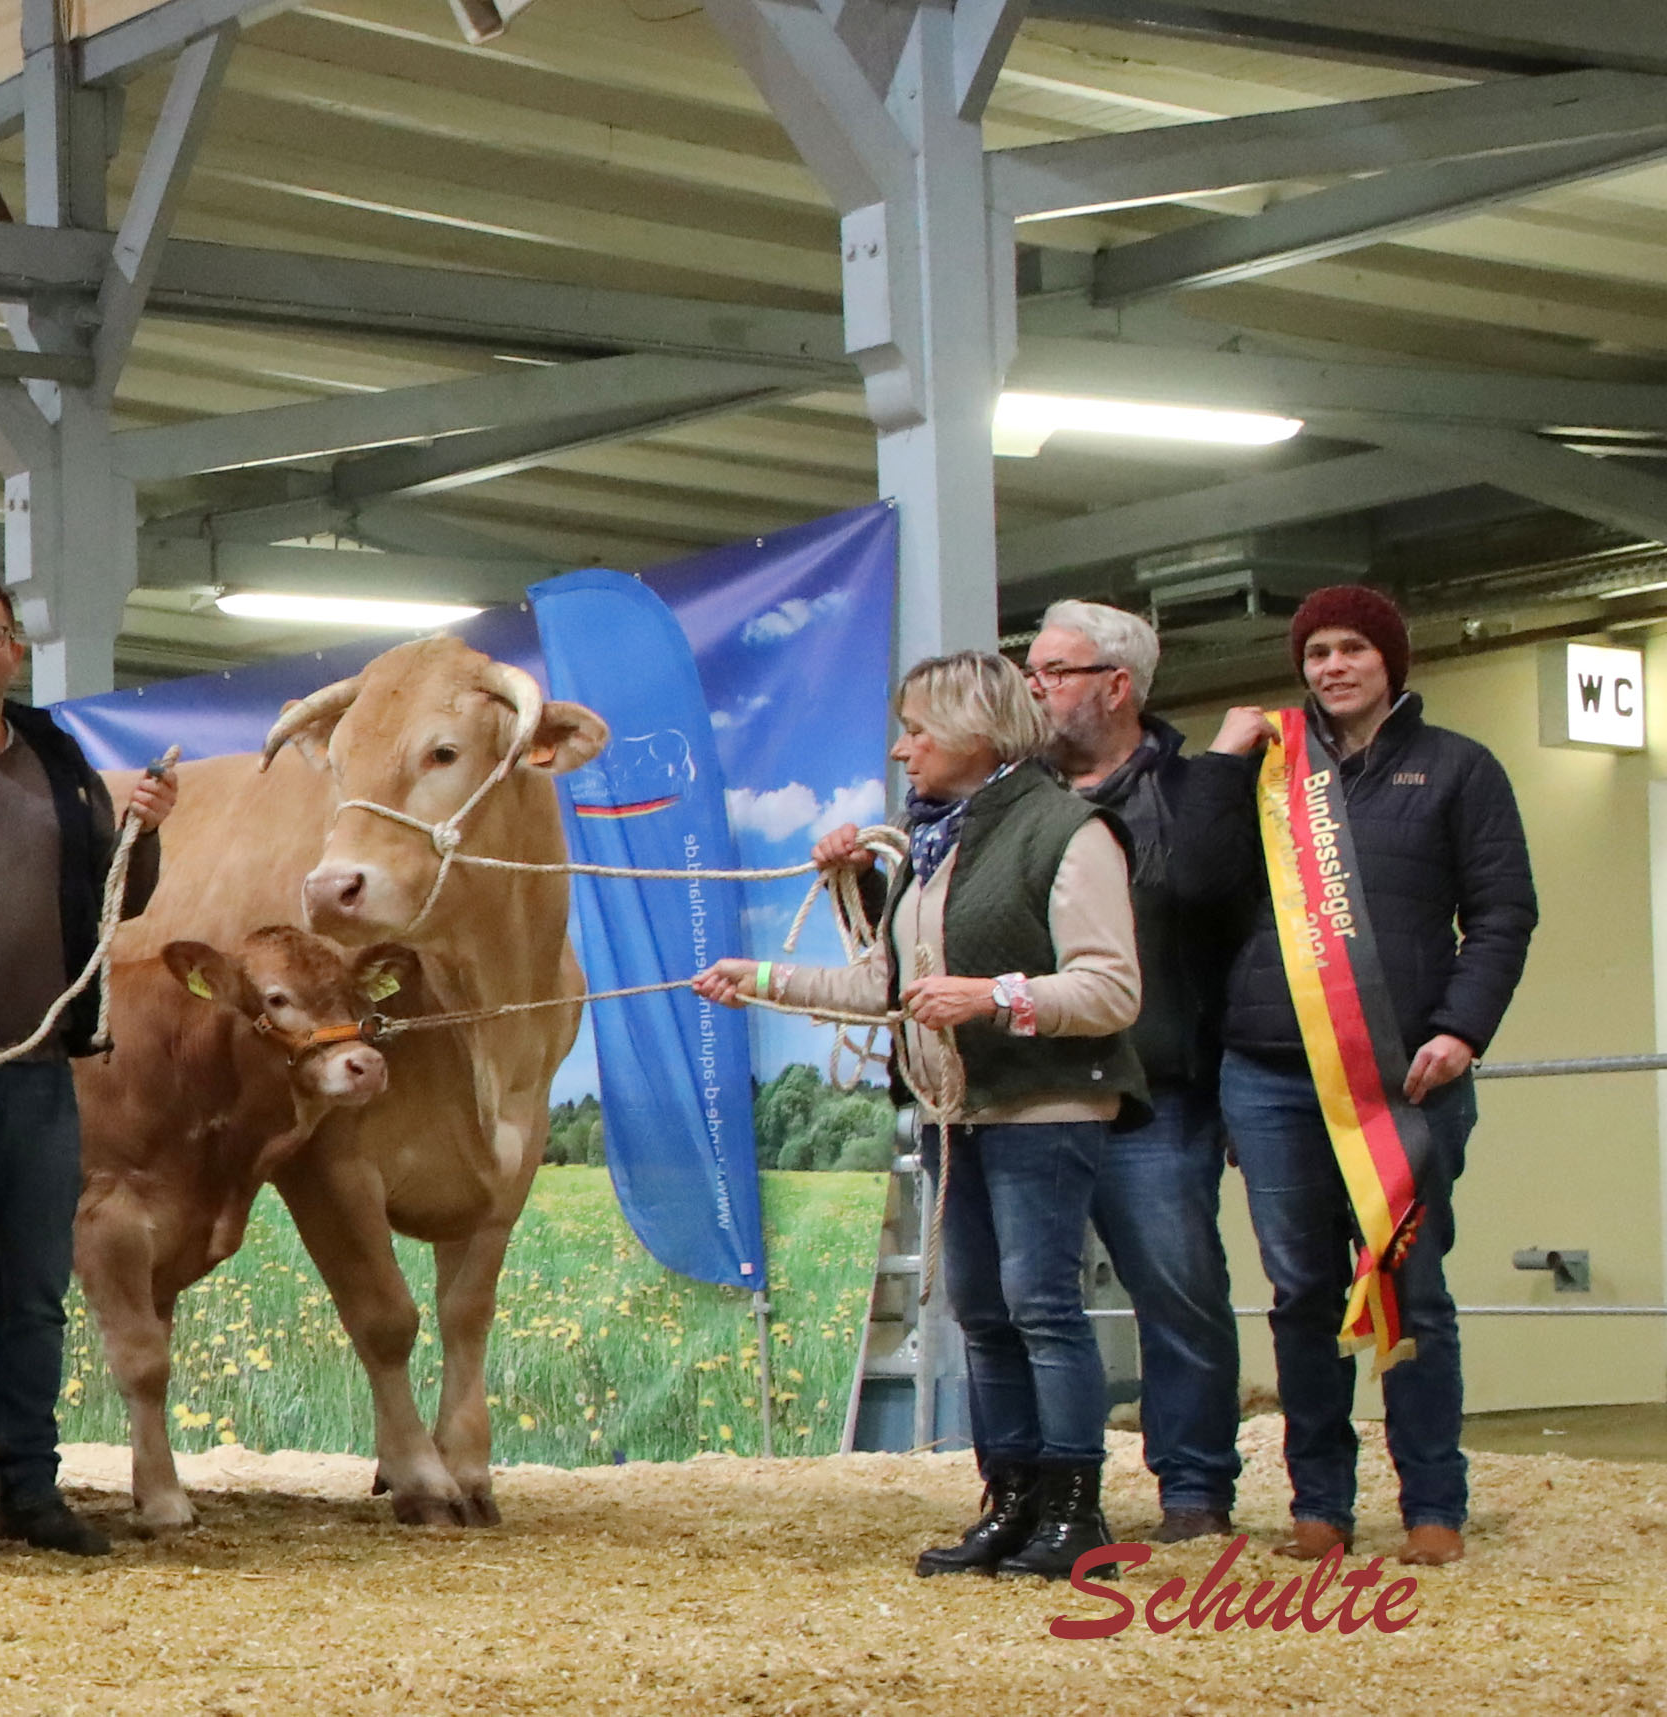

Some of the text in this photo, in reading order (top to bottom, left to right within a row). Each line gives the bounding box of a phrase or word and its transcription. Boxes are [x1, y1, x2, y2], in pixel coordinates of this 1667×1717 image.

[1577, 673, 1633, 718] WC
[1303, 769, 1357, 938] Bundessieger
[1291, 911, 1330, 973] 2021
